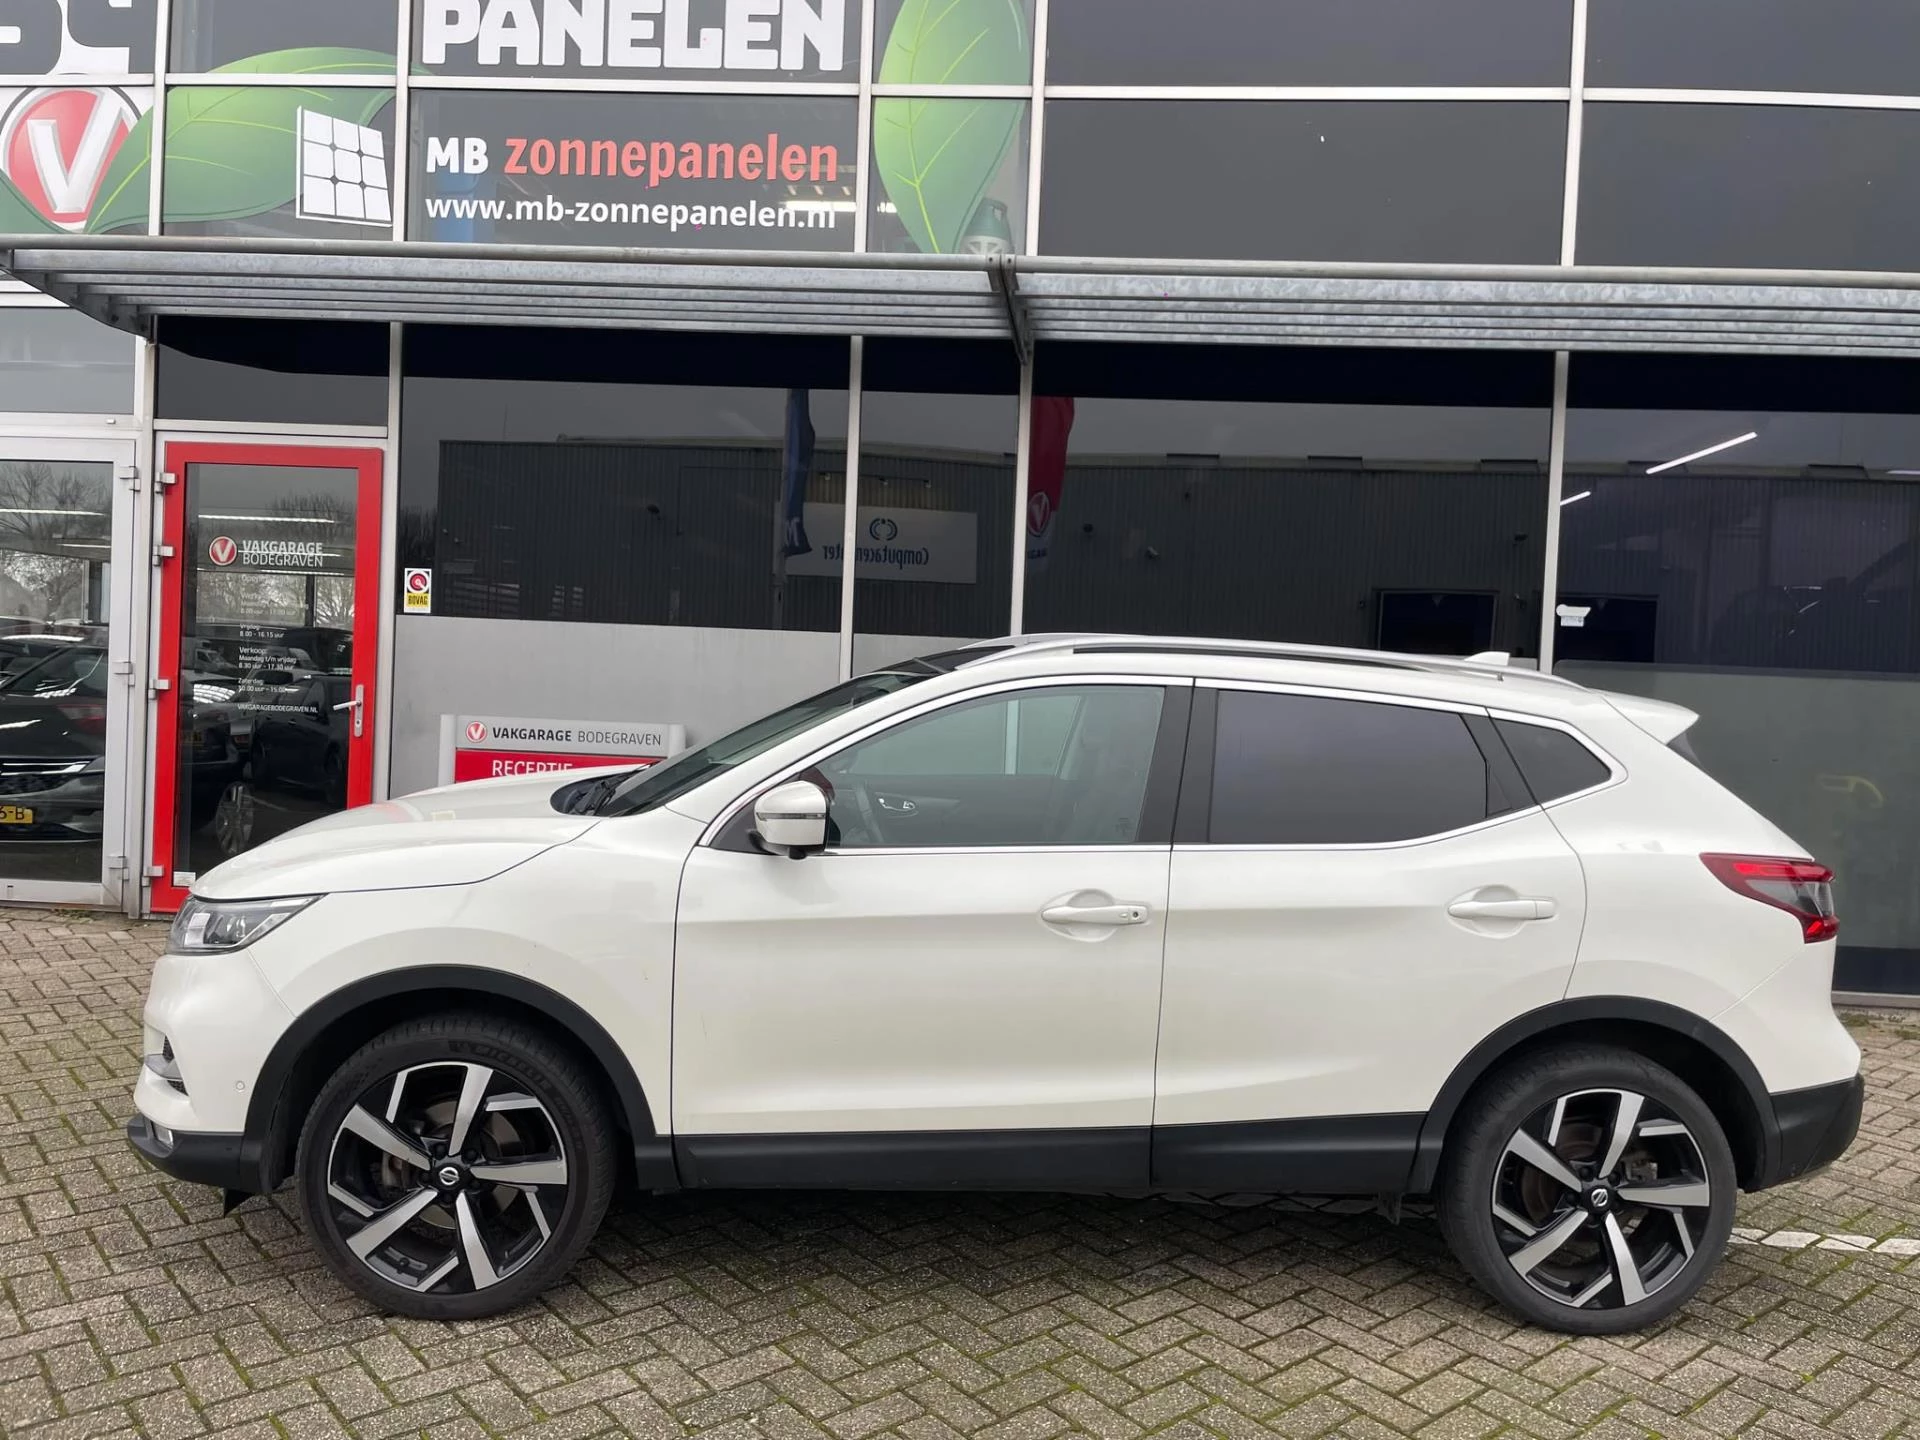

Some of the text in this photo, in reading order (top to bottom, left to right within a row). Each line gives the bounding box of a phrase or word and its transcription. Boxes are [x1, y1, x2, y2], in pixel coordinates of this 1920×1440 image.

[422, 0, 845, 70] PANELEN
[426, 133, 838, 187] MB zonnepanelen
[425, 195, 836, 231] www.mb-zonnepanelen.nl
[242, 540, 323, 554] VAKGARAGE
[242, 553, 323, 567] BODEGRAVEN
[408, 595, 428, 605] BOVAG
[239, 654, 264, 663] Maandag
[492, 727, 572, 742] VAKGARAGE
[578, 731, 662, 746] BODEGRAVEN
